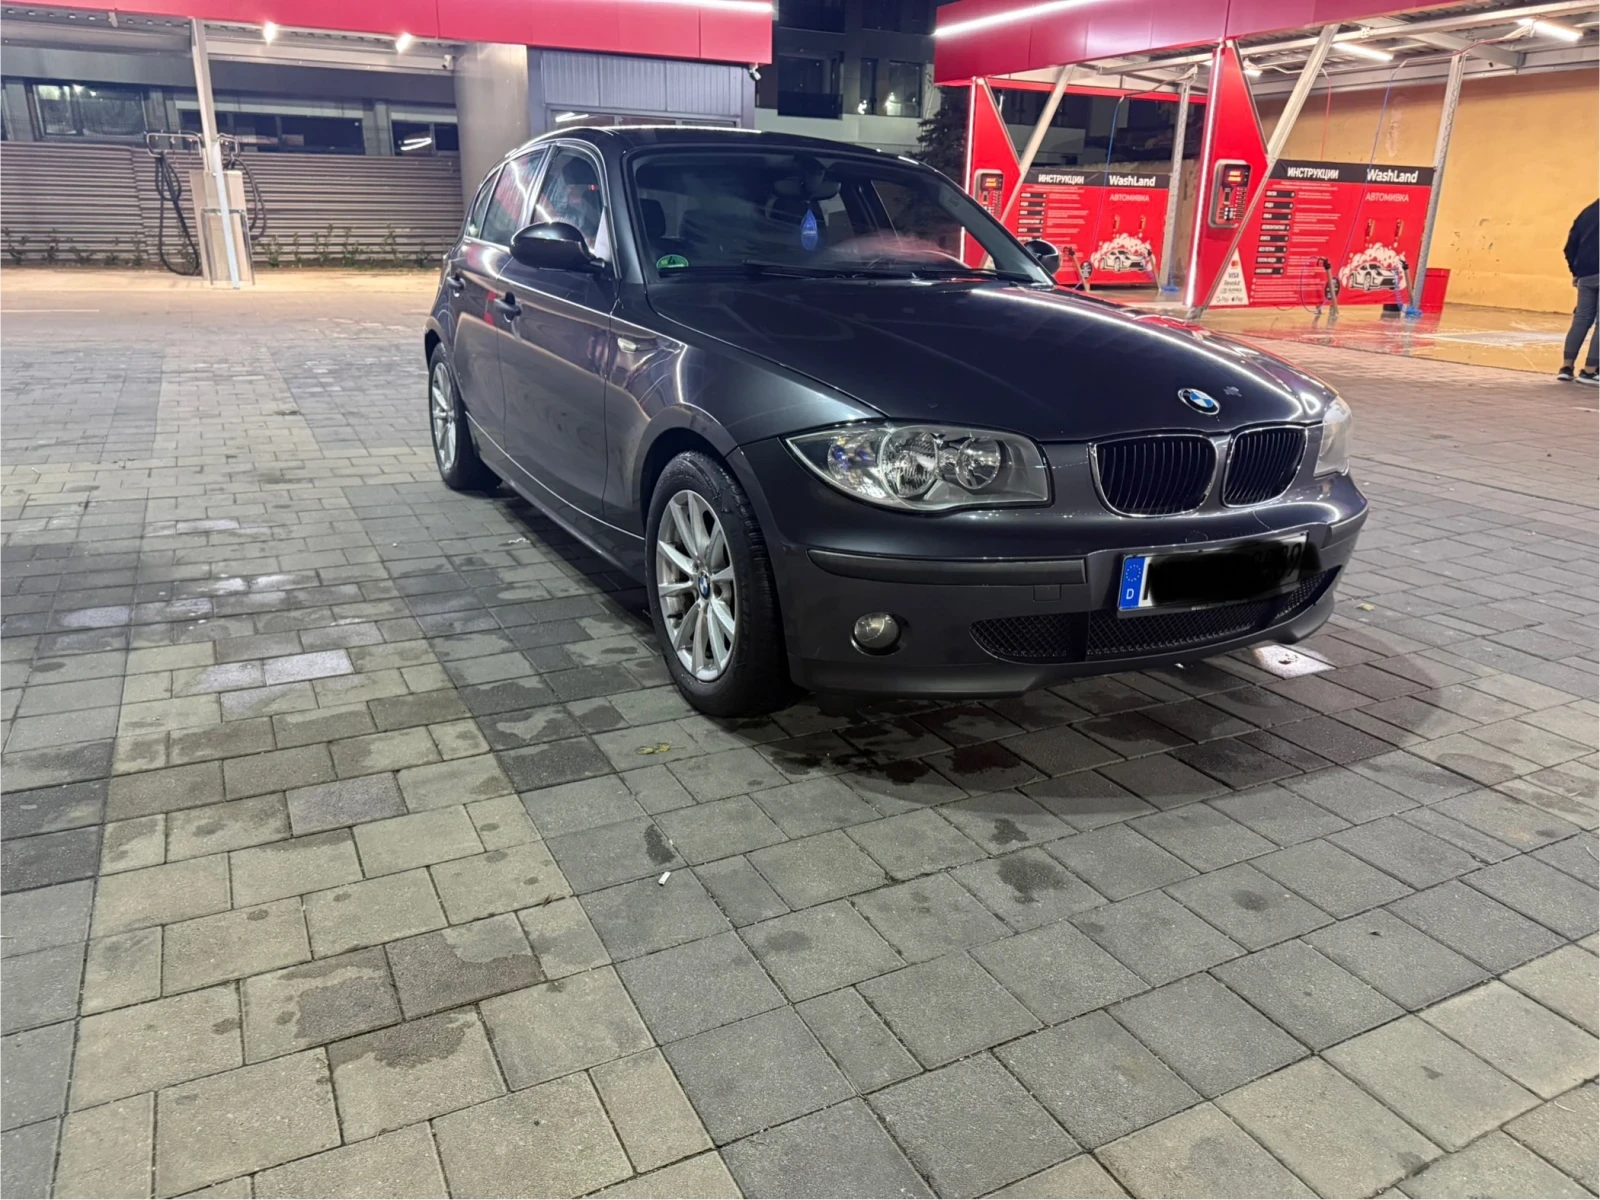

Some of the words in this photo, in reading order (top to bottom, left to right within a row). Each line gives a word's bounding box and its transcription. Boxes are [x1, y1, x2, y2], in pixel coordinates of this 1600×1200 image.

[1038, 174, 1085, 185] ИНСТРУКЦИИ
[1287, 167, 1339, 180] ИНСТРУКЦИИ
[1367, 168, 1418, 183] WashLand
[1109, 174, 1156, 187] WashLand
[1109, 193, 1150, 202] АВТОМИВКА
[1365, 192, 1410, 202] АВТОМИВКА
[1126, 588, 1135, 600] D
